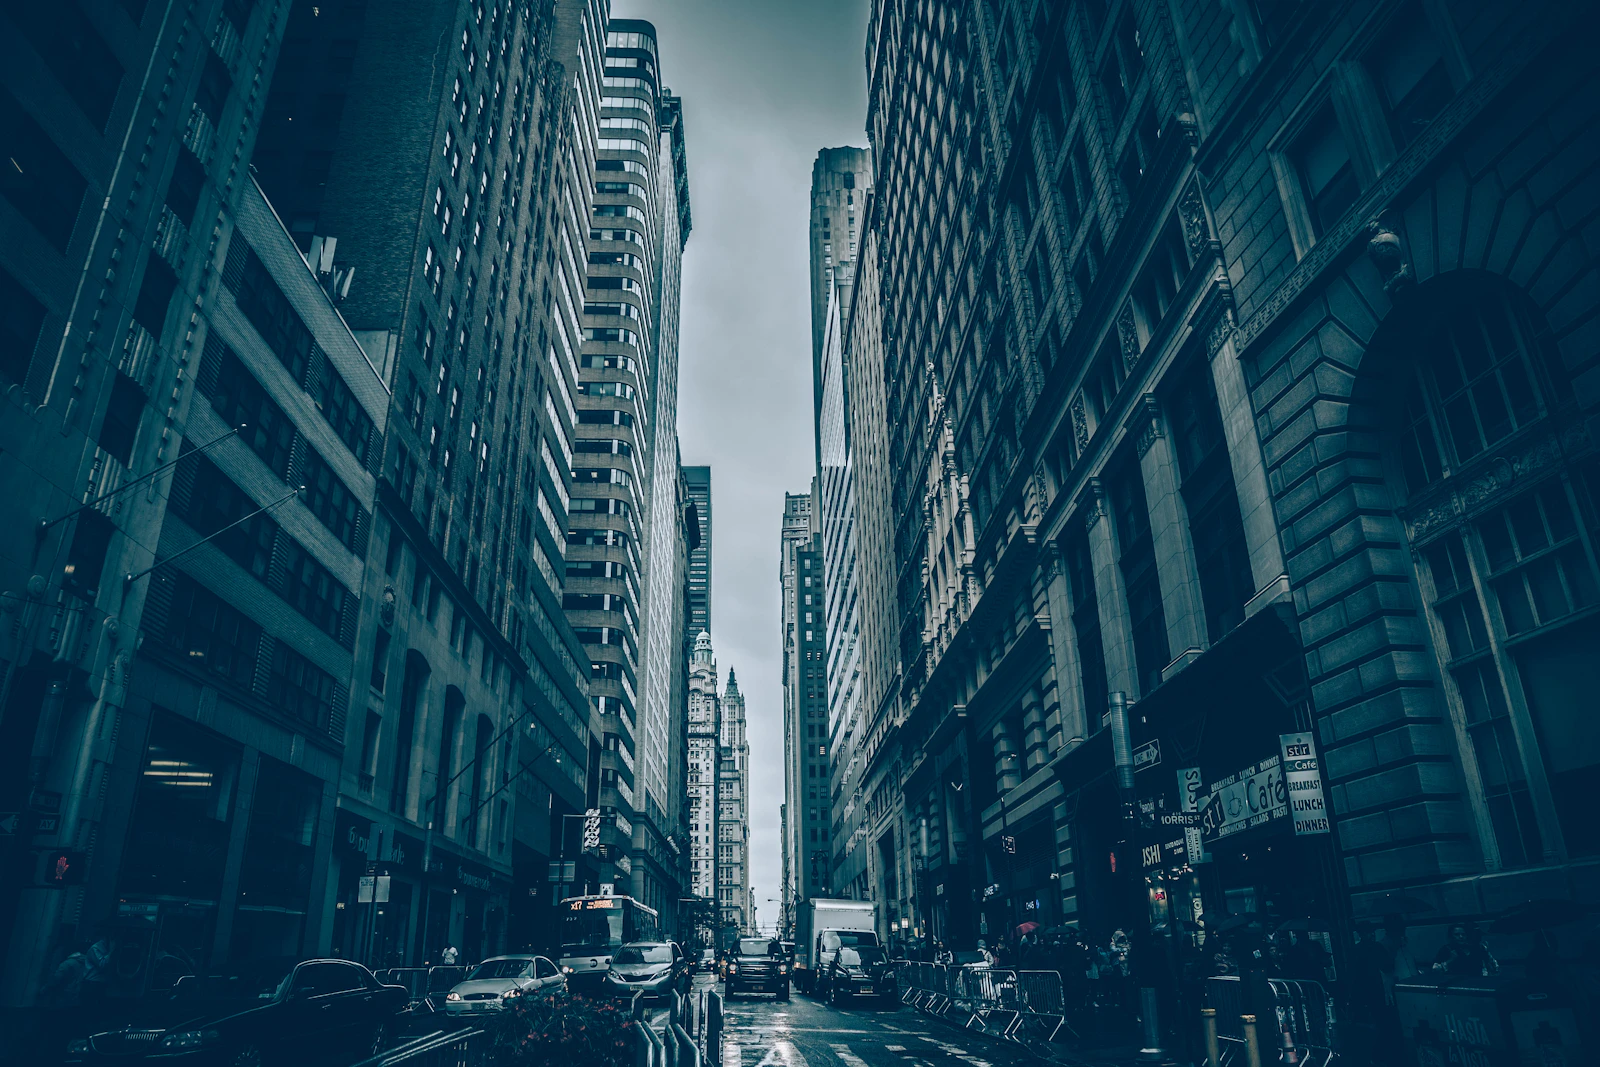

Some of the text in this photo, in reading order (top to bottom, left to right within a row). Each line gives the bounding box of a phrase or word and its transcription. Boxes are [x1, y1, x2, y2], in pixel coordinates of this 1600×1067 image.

[1135, 753, 1144, 764] ONE
[1294, 761, 1317, 770] Café
[1211, 775, 1236, 792] BREAKFAST
[1239, 766, 1256, 780] LUNCH
[1289, 780, 1321, 792] BREAKFAST
[1247, 773, 1287, 813] Café
[1293, 799, 1323, 811] LUNCH
[40, 820, 54, 830] AY
[1219, 820, 1247, 837] SANDWICHES
[1250, 812, 1269, 827] SALADS
[1296, 819, 1329, 832] DINNER
[1445, 1013, 1491, 1046] HASTA
